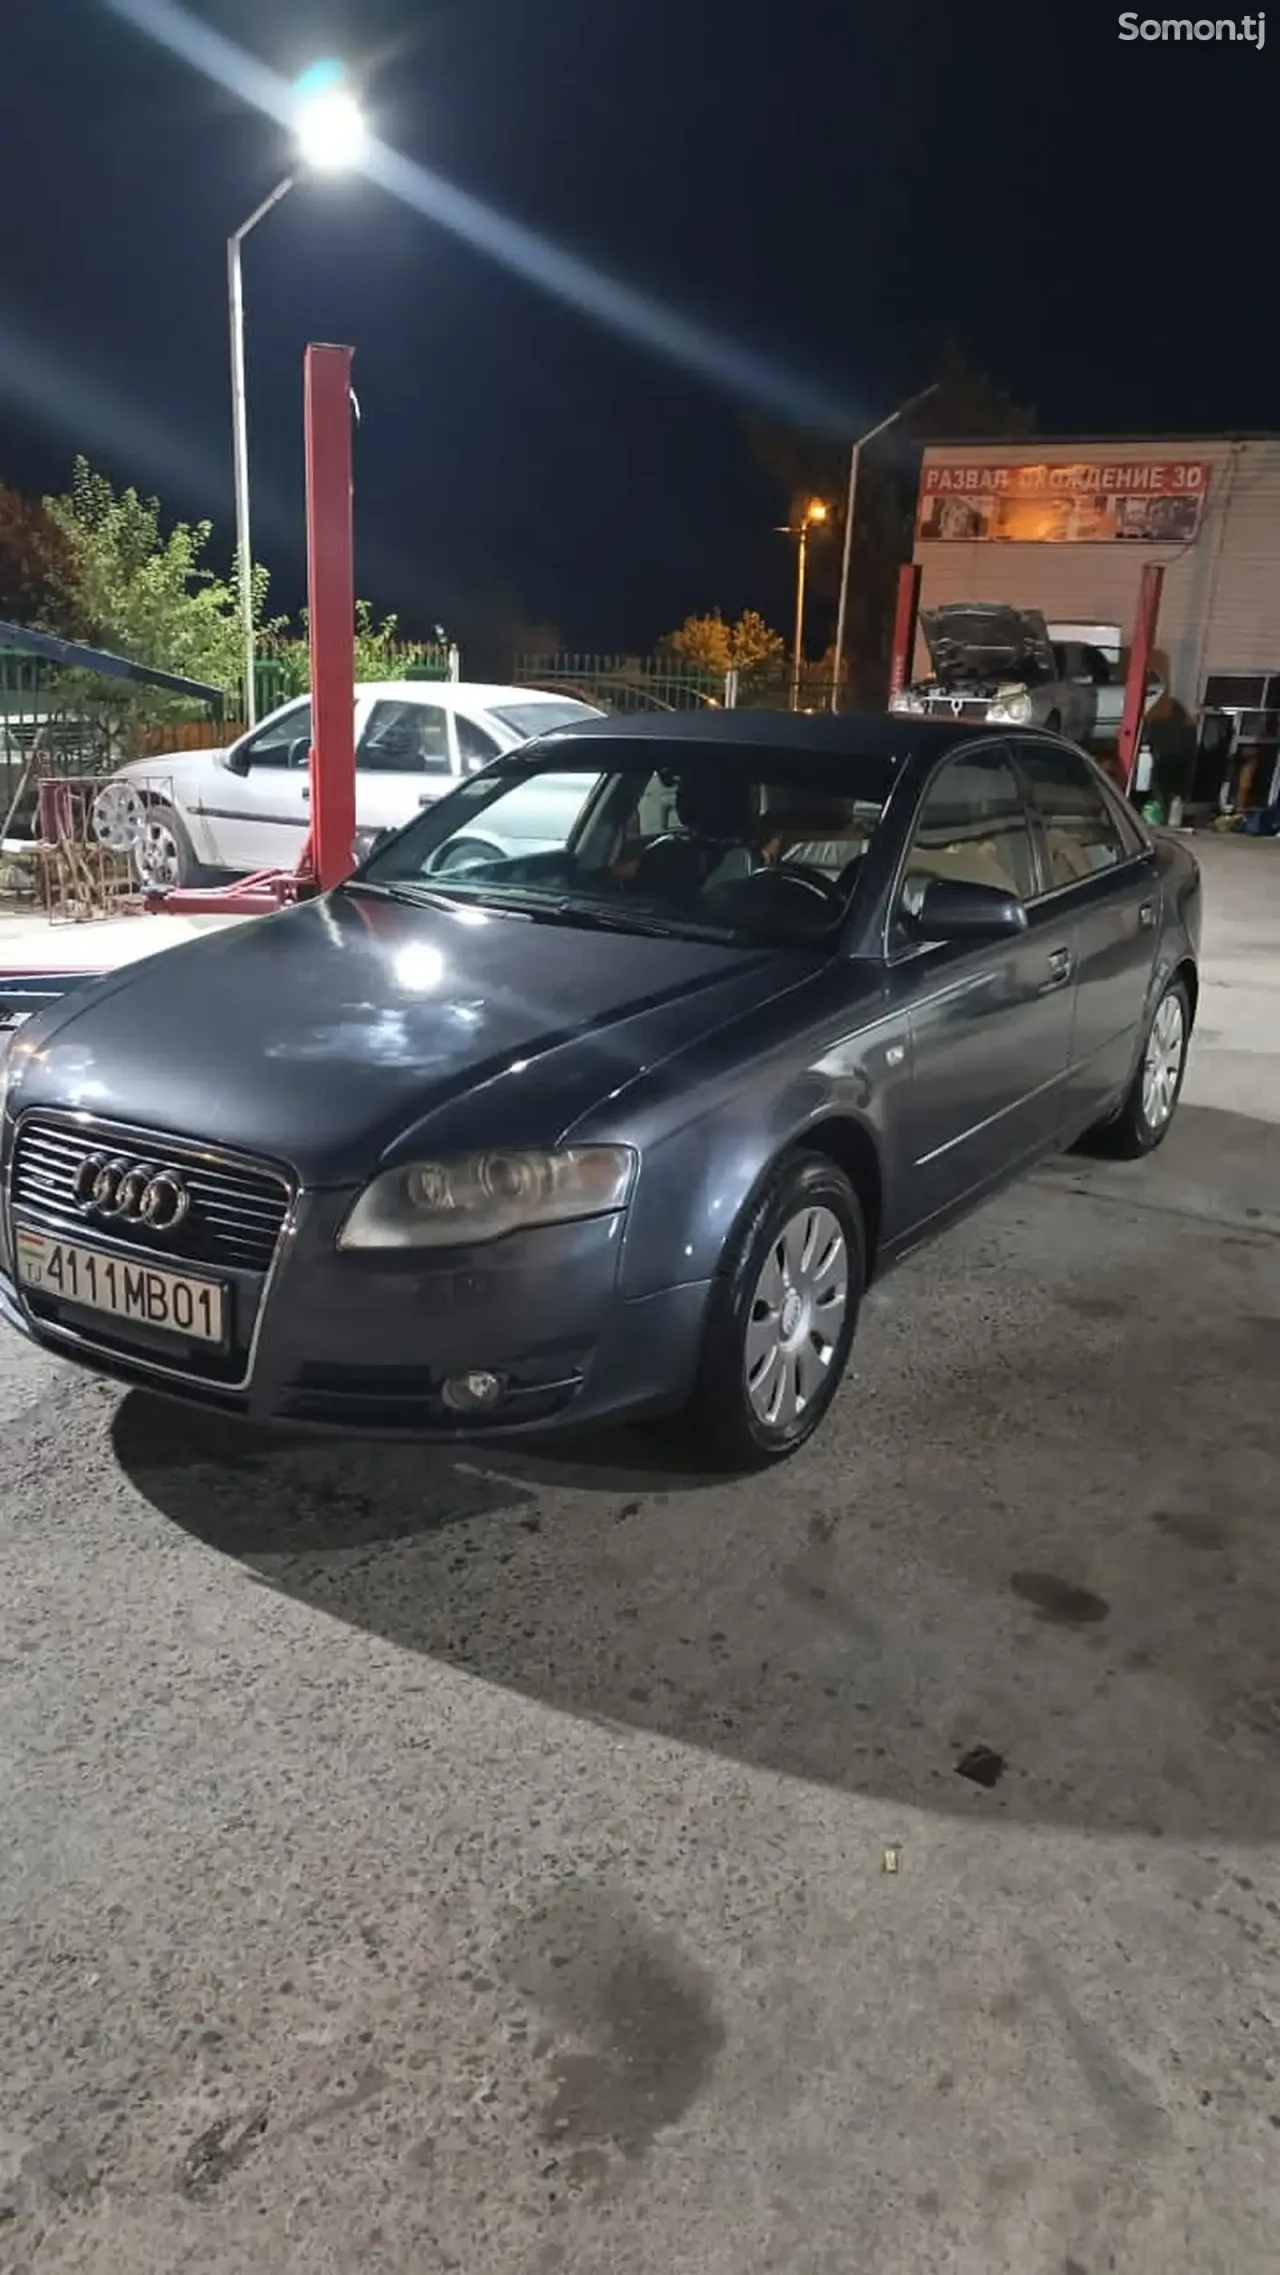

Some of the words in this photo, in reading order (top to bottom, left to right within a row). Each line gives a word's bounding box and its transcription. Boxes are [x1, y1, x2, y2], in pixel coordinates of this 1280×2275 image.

[926, 467, 1009, 490] РАЗВАЛ
[26, 1262, 42, 1282] TJ
[47, 1245, 212, 1336] 4111MB01
